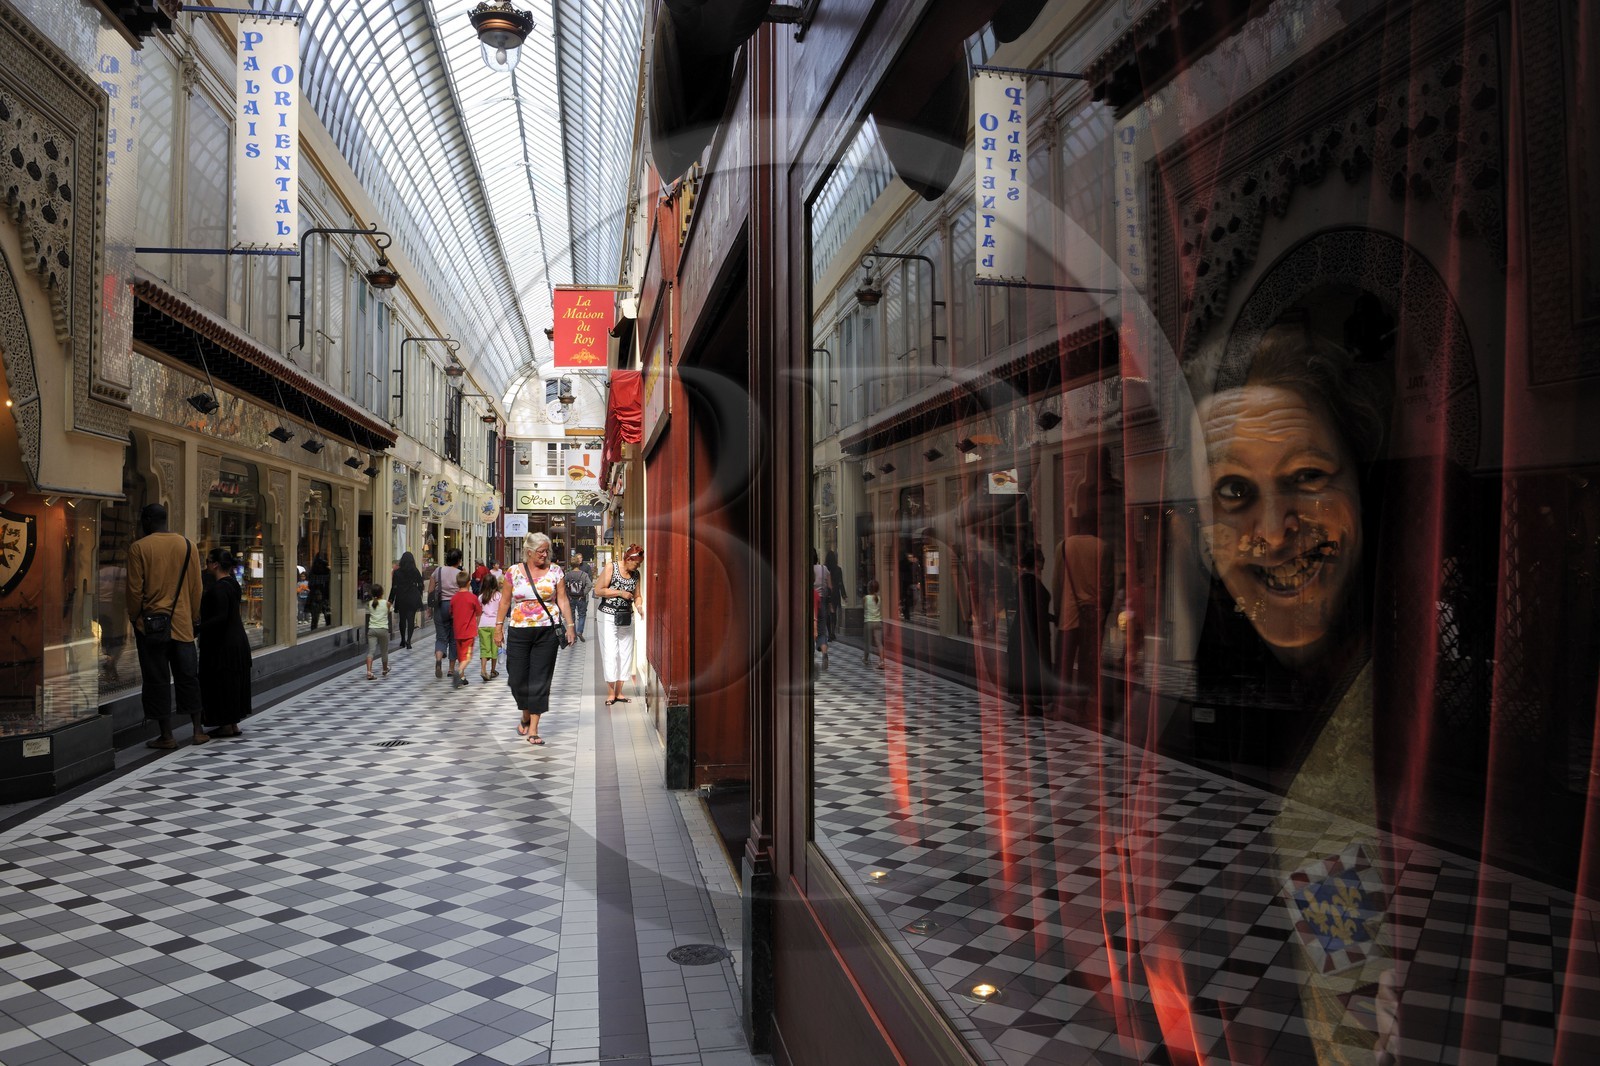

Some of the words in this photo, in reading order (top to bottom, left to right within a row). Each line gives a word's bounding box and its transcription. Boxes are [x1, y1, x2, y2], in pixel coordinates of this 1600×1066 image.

[240, 31, 264, 159] PALAIS
[271, 64, 294, 236] ORIENTAL
[576, 295, 591, 306] La
[562, 307, 604, 319] Maison
[577, 319, 591, 332] du
[573, 333, 595, 347] Roy
[520, 495, 556, 505] Hôtel
